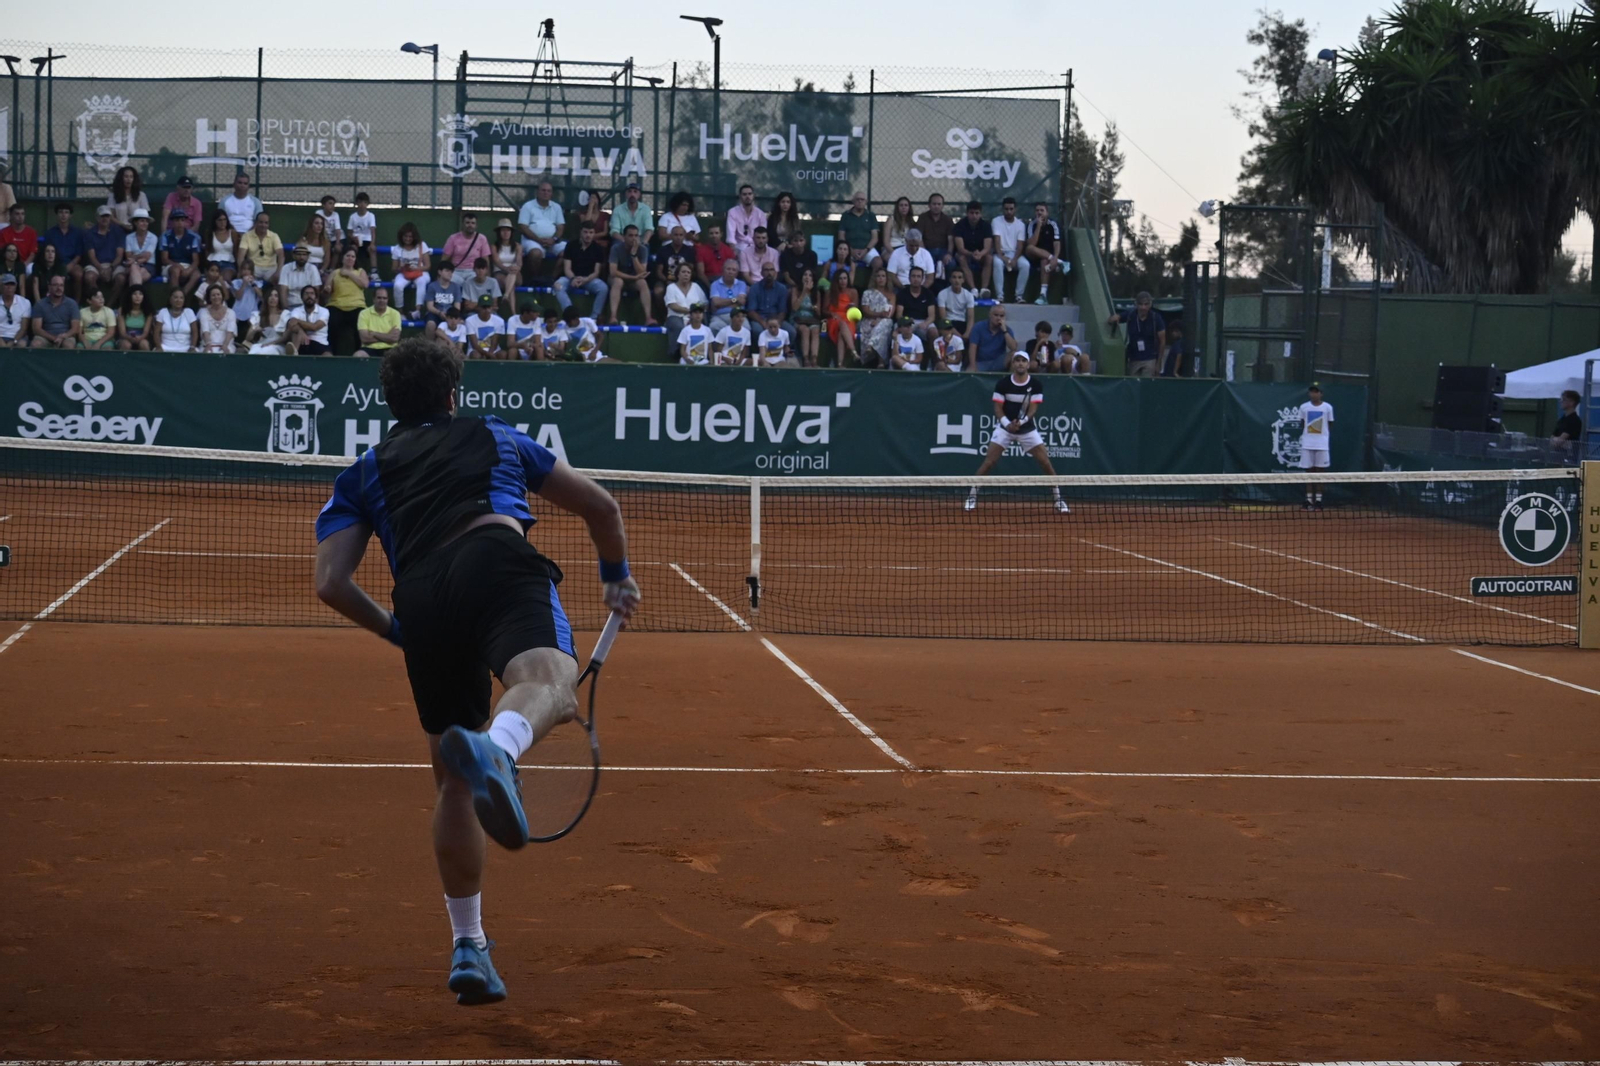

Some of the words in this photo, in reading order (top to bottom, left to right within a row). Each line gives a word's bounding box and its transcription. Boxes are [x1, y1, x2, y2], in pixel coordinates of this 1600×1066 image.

[246, 115, 370, 139] DIPUTACIÓN
[490, 119, 615, 139] Ayuntamiento
[620, 122, 643, 139] de
[246, 137, 273, 154] DE
[284, 137, 369, 156] HUELVA
[699, 123, 849, 163] Huelva
[247, 154, 324, 169] OBJETIVOS
[492, 144, 648, 177] HUELVA
[910, 148, 1021, 188] Seabery
[795, 167, 849, 184] original
[341, 382, 523, 411] Ayuiento
[531, 387, 563, 410] de
[16, 401, 163, 446] Seabery
[614, 387, 831, 444] Huelva
[755, 450, 830, 474] original
[1046, 451, 1081, 459] OSTENIBLE
[1510, 497, 1562, 518] BMW
[1588, 506, 1600, 604] HUELVA
[1477, 579, 1573, 593] AUTOGOTRAN
